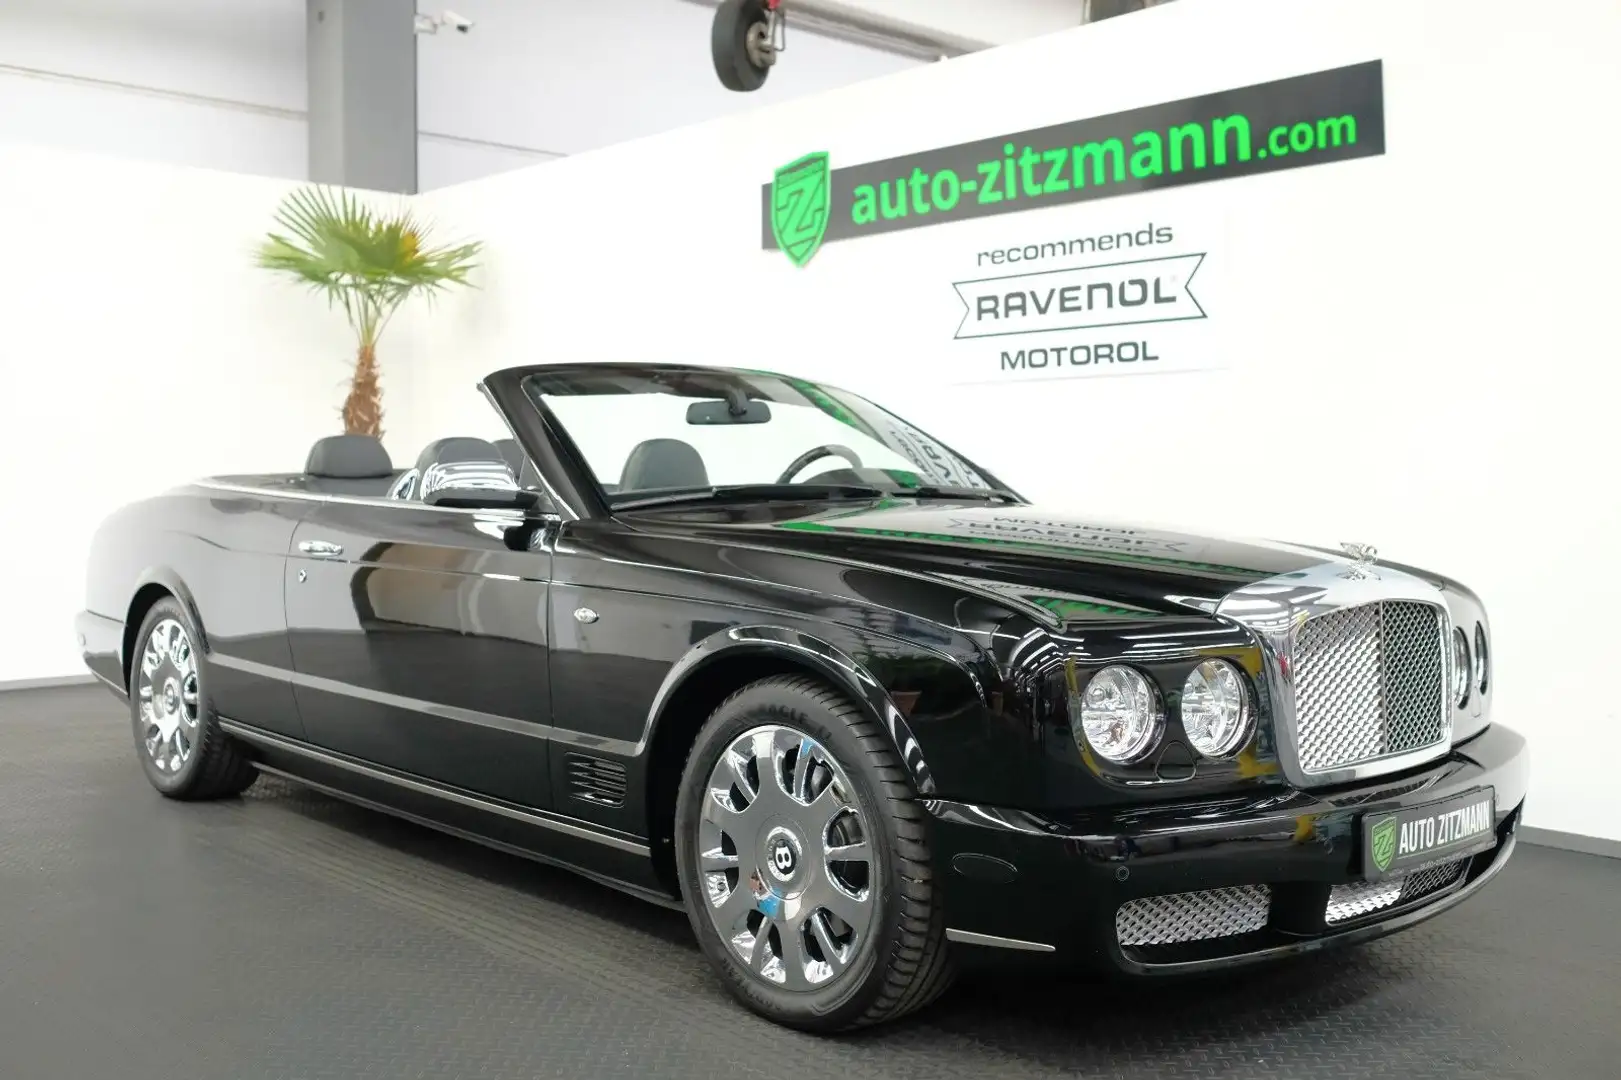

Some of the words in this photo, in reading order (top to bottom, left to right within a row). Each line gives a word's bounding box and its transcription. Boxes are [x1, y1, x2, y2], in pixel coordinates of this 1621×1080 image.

[851, 112, 1356, 224] auto-zitzmann.com
[977, 222, 1173, 266] recommends
[977, 277, 1177, 321] RAVENOL
[1001, 341, 1159, 370] MOTOROL
[1399, 817, 1435, 854] AUTO
[1437, 800, 1490, 845] ZITZMANN
